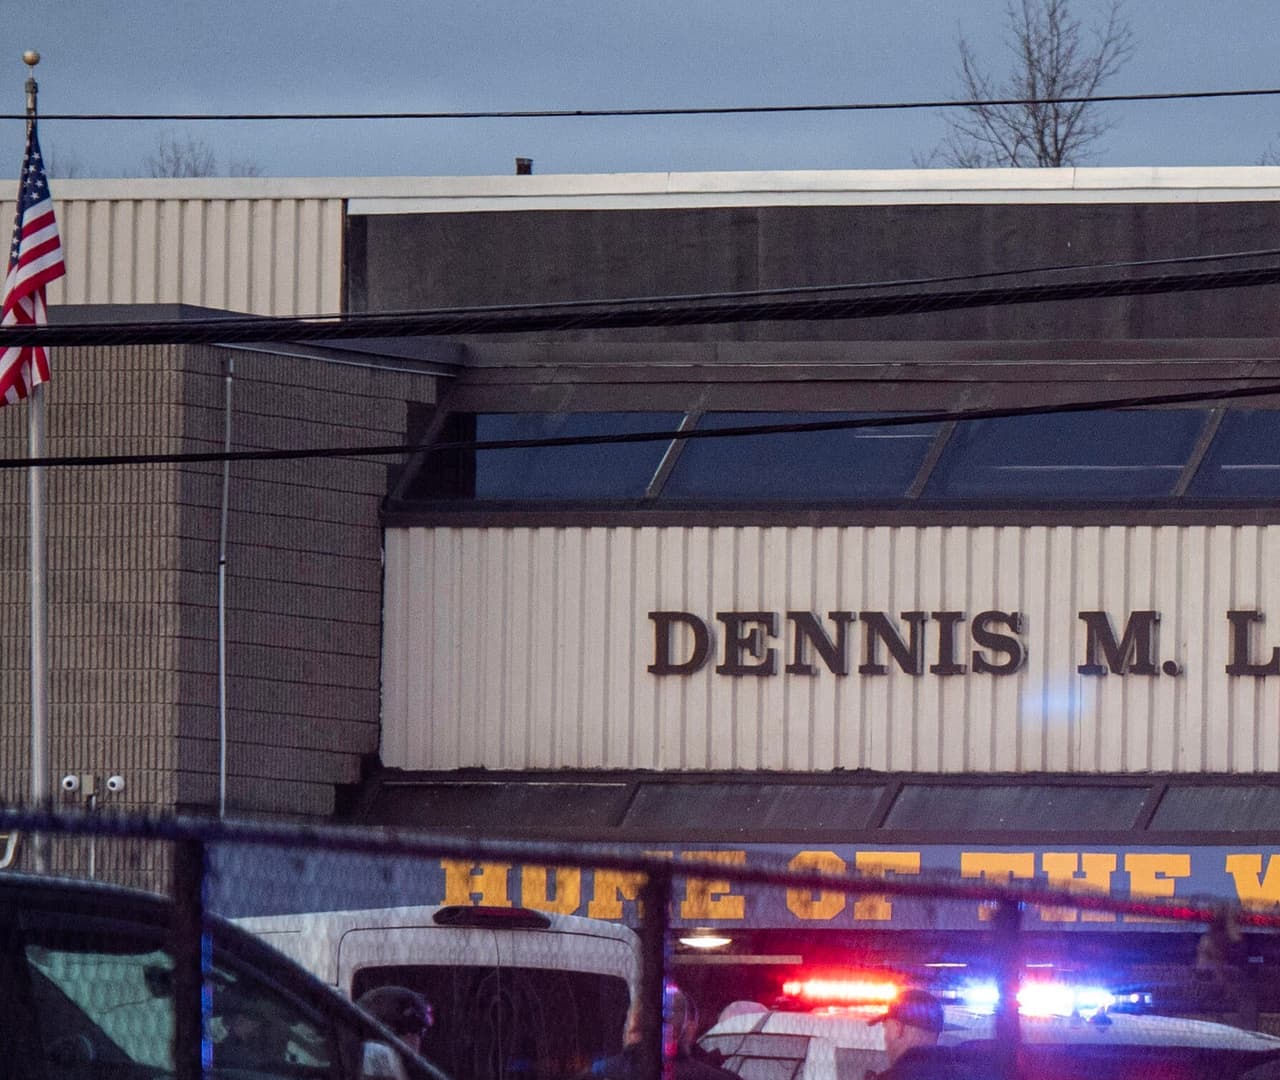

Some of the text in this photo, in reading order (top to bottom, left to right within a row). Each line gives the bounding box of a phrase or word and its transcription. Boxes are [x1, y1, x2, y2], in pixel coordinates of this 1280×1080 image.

[647, 610, 1026, 676] DENNIS
[1078, 610, 1185, 677] M.
[786, 850, 921, 921] OF
